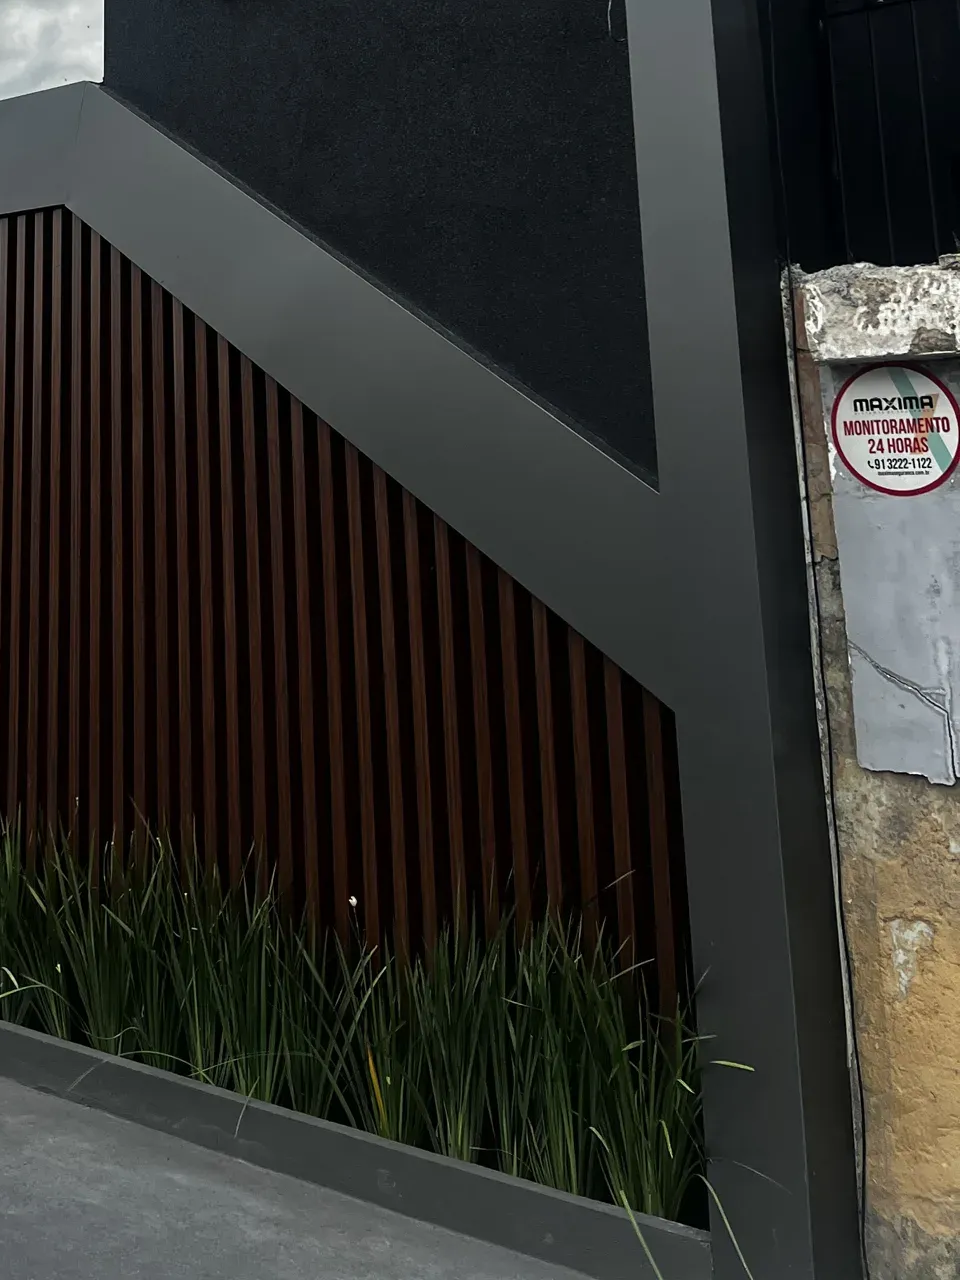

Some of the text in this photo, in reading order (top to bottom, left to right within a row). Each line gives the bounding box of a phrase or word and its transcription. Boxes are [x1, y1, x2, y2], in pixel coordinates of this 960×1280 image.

[843, 417, 951, 437] MONITORAMENTO
[868, 437, 929, 454] 24 HORAS
[887, 457, 932, 469] 3222-1122
